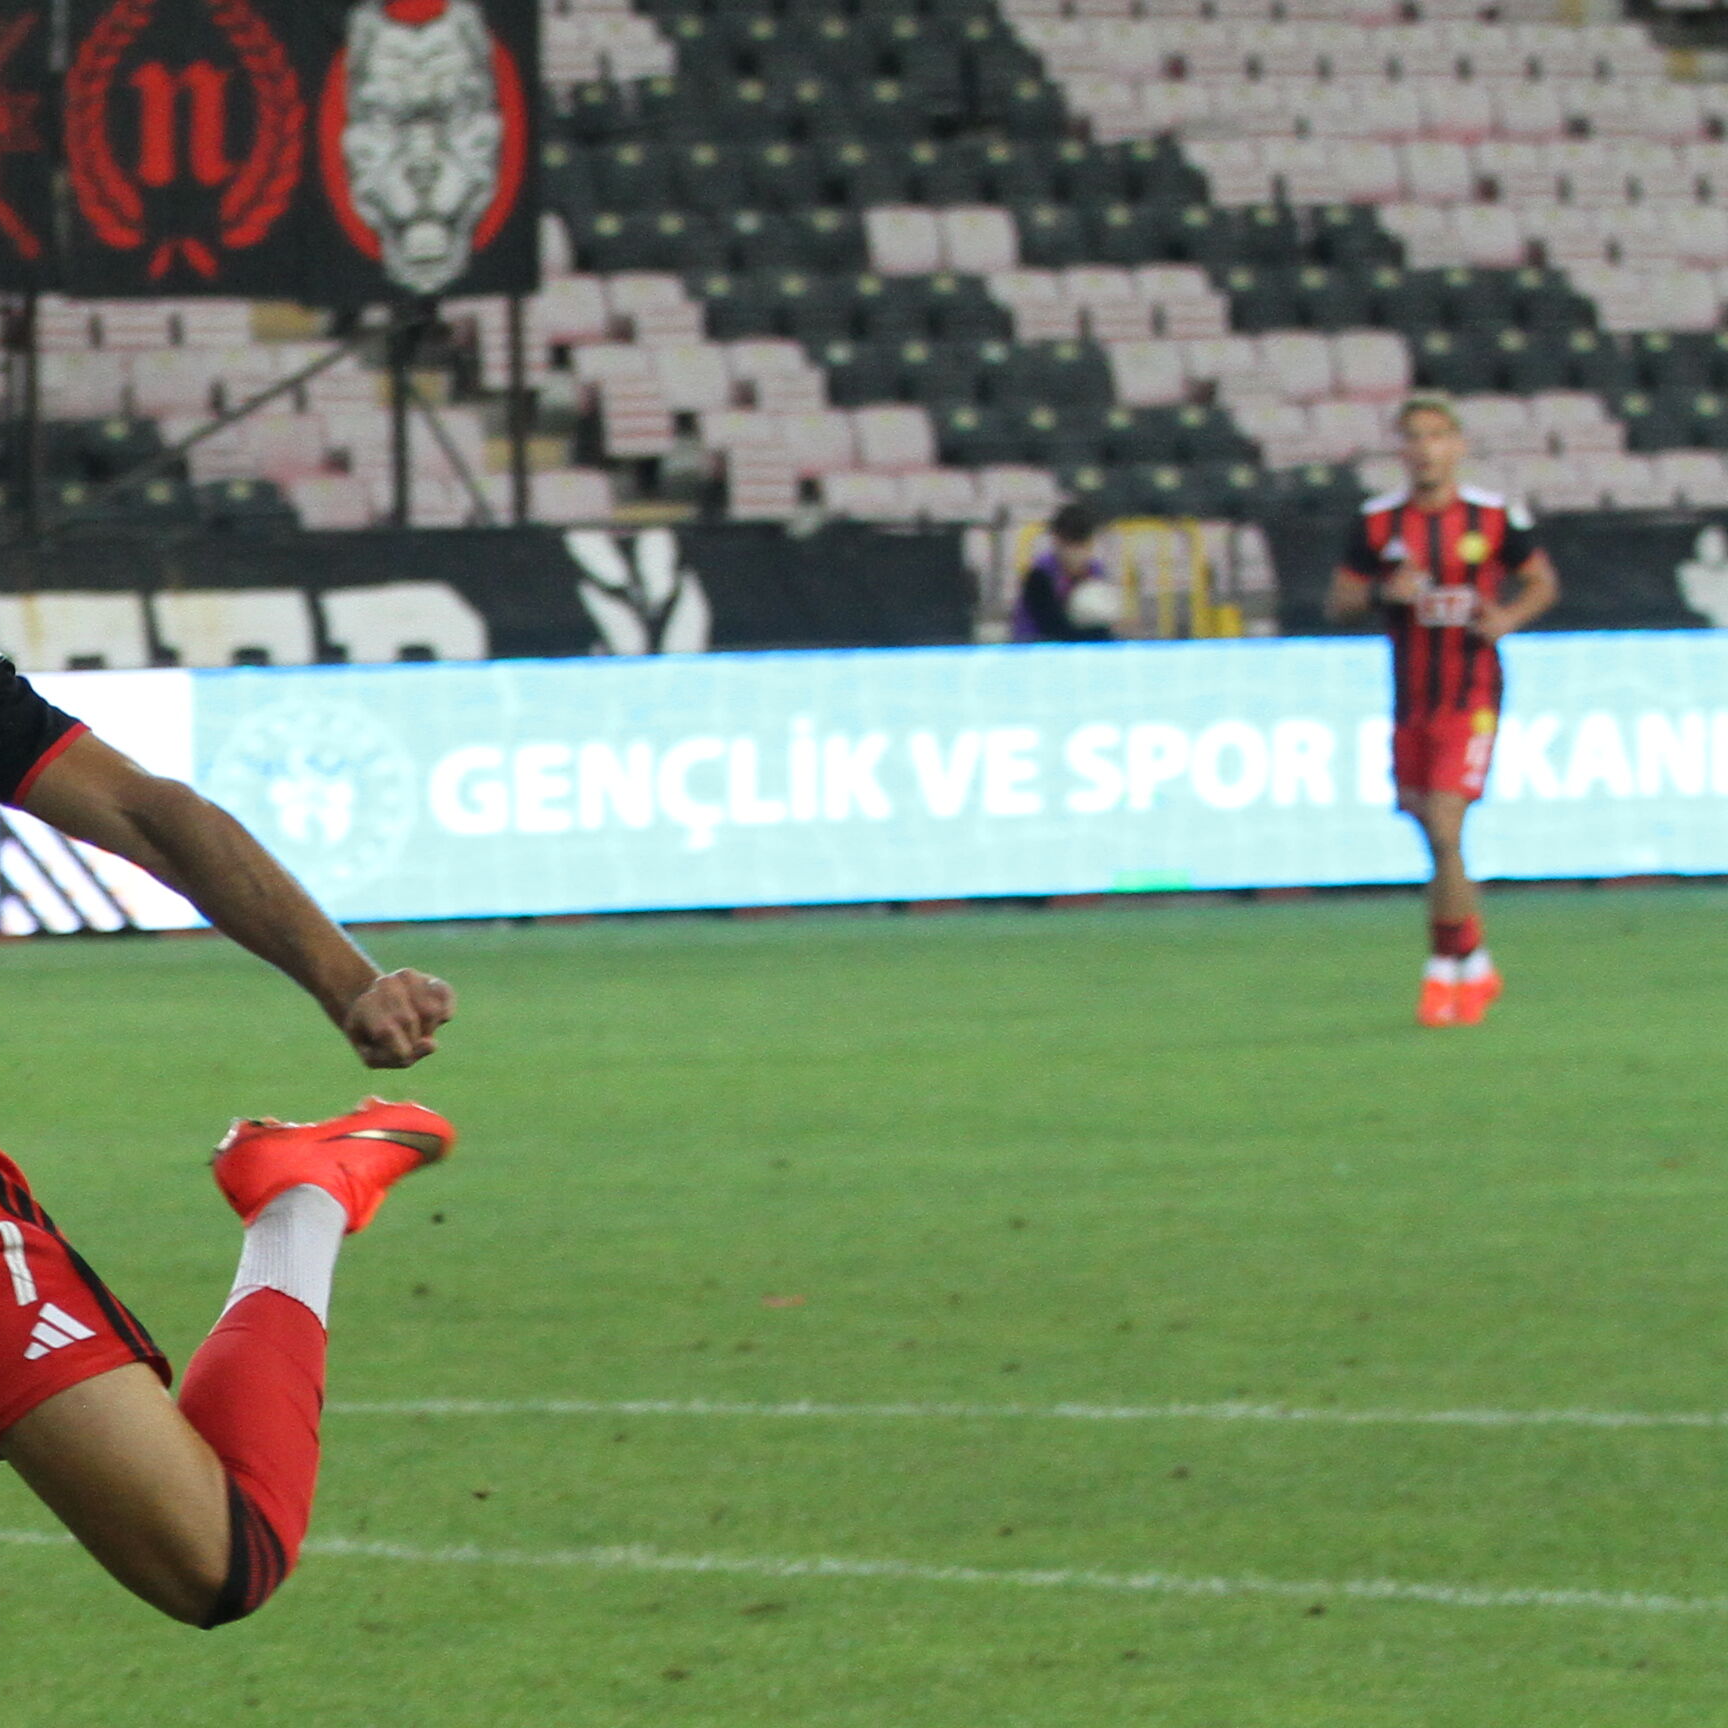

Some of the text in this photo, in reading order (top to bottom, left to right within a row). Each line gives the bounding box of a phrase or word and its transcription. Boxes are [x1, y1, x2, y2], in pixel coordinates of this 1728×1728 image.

[427, 715, 892, 852] GENÇLİK
[910, 726, 1043, 819] VE
[1065, 718, 1335, 815] SPOR
